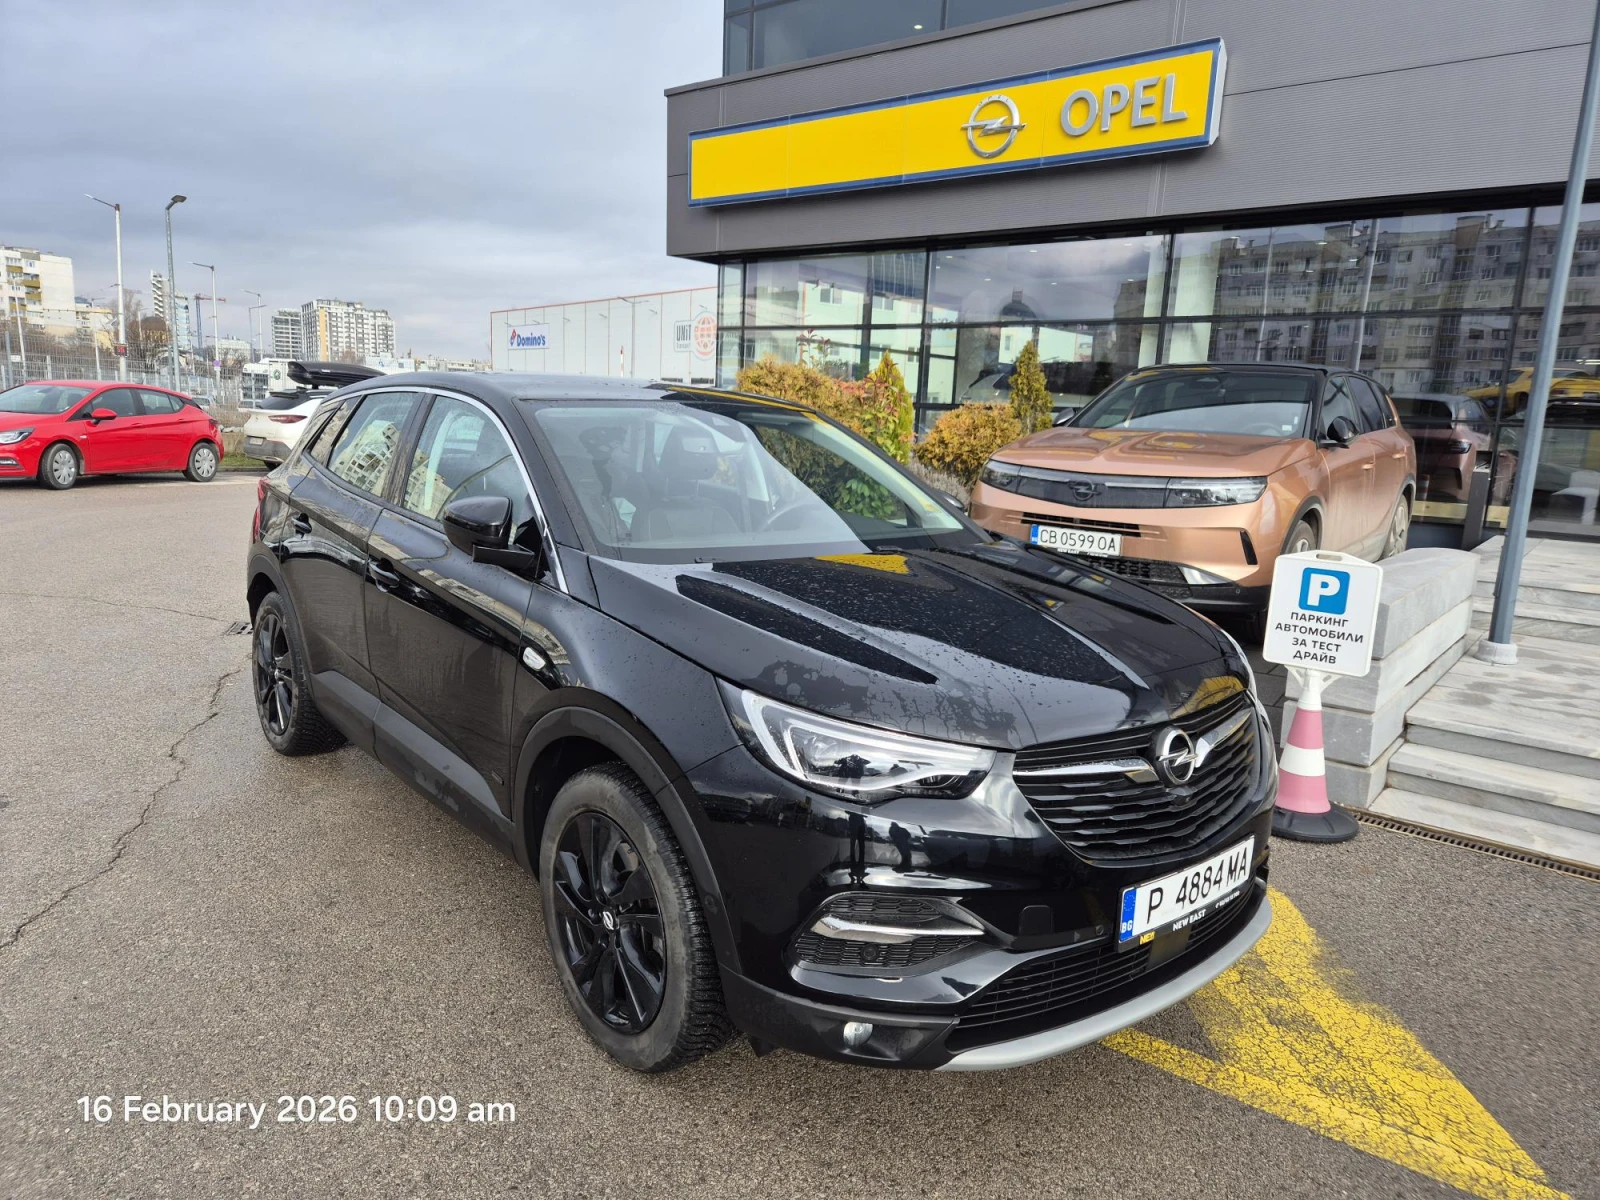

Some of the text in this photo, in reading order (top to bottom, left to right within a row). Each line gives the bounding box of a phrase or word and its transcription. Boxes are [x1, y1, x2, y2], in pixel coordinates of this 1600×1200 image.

[1060, 73, 1188, 136] OPEL
[516, 332, 546, 347] Domino's
[1040, 529, 1057, 544] CB
[1060, 531, 1095, 549] 0599
[1097, 536, 1116, 552] OA
[1307, 573, 1341, 606] P
[1290, 611, 1349, 628] ПАРКИНГ
[1275, 622, 1364, 644] АВТОМОБИЛИ
[1291, 637, 1341, 653] ЗА ТЕСТ
[1293, 650, 1337, 665] ДРАЙВ
[1146, 886, 1164, 925] P
[1175, 859, 1225, 910] 4884
[1226, 846, 1248, 887] MA
[1120, 919, 1133, 934] BG
[1172, 909, 1207, 931] NEW EAST
